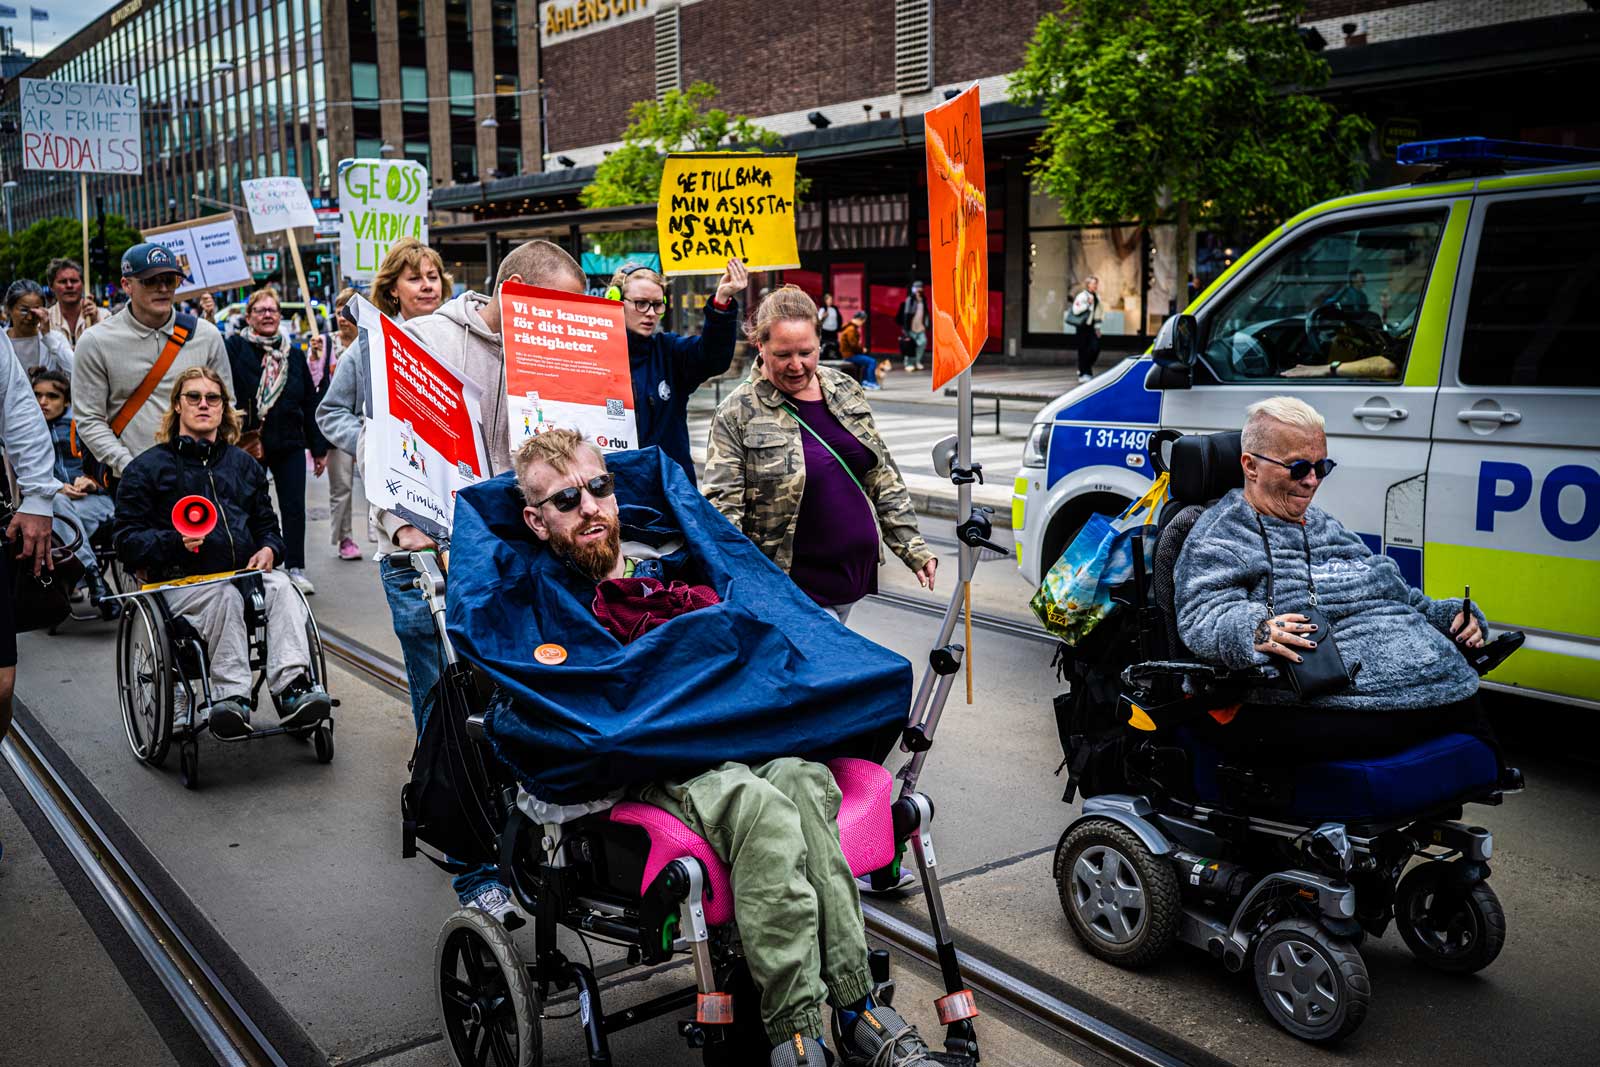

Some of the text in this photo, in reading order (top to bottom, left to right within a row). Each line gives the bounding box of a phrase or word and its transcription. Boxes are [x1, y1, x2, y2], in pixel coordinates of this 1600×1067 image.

[22, 81, 137, 108] ASSISTANS
[23, 106, 138, 133] ÄR FRIHET
[25, 132, 96, 170] RÄDDA
[345, 163, 420, 205] GE OSS
[677, 172, 698, 193] GE
[671, 194, 709, 213] MIN
[668, 214, 754, 239] NS SLUTA
[511, 301, 614, 328] Vi tar kampen
[513, 316, 608, 340] för ditt barns
[513, 332, 597, 354] rättigheter.
[393, 362, 450, 417] rättigheter.
[429, 379, 458, 410] barns
[609, 437, 628, 449] rbu
